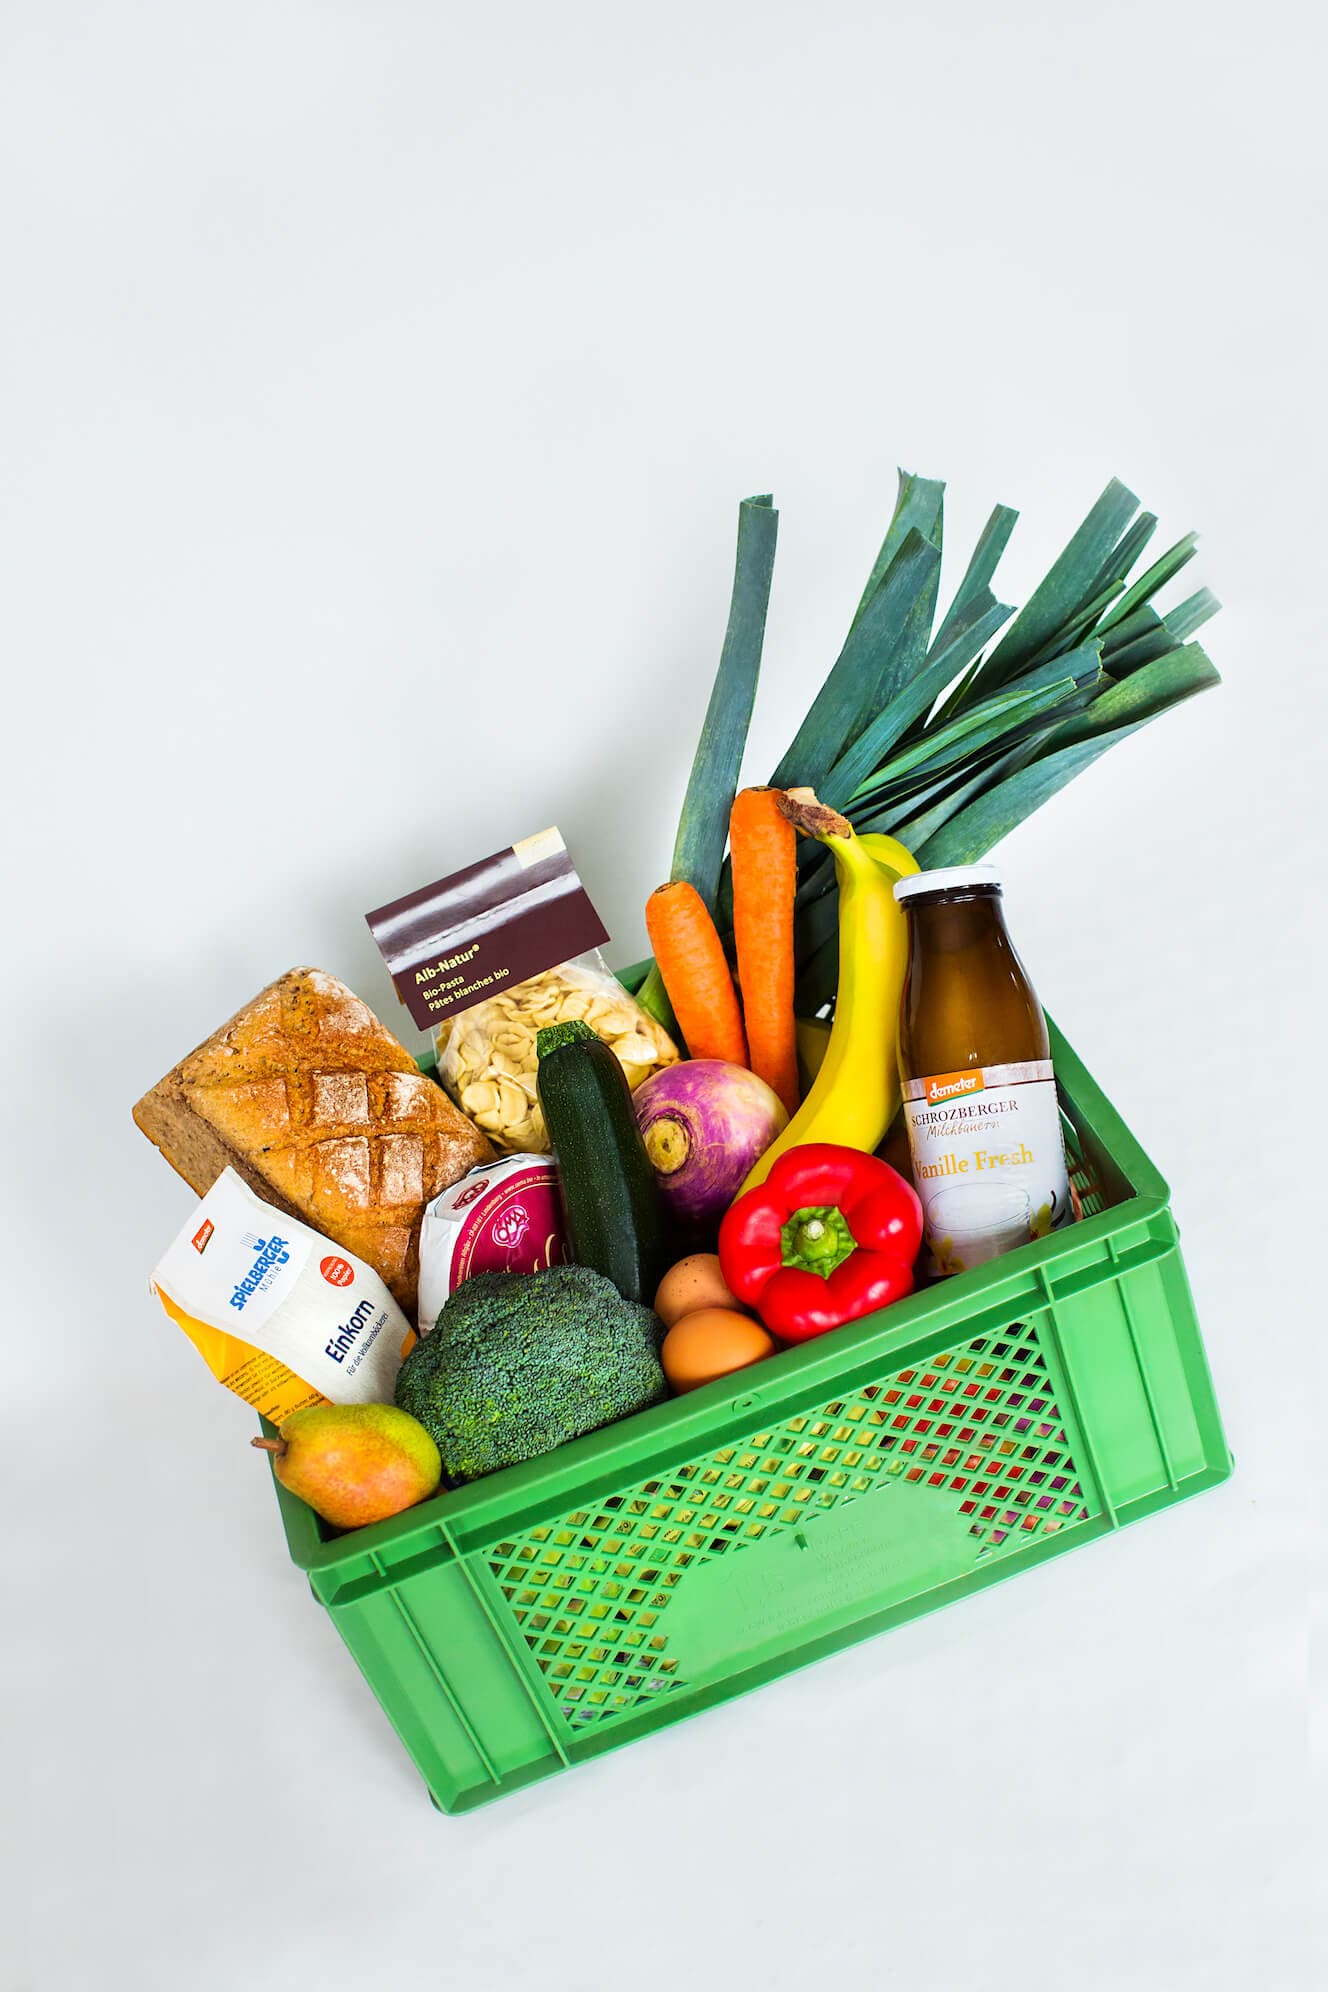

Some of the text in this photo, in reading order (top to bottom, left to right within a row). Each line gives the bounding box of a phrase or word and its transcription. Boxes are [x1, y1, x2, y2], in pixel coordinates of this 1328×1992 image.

[422, 975, 465, 1000] Bio-Pasta
[428, 968, 510, 1012] Pâtes blanches bio
[929, 1077, 977, 1098] demeter
[911, 1100, 1019, 1127] SCHROZBERGER
[914, 1143, 1034, 1179] Vanille Fresh
[229, 1235, 289, 1311] SPIELBERGER
[325, 1300, 375, 1364] Einkorn
